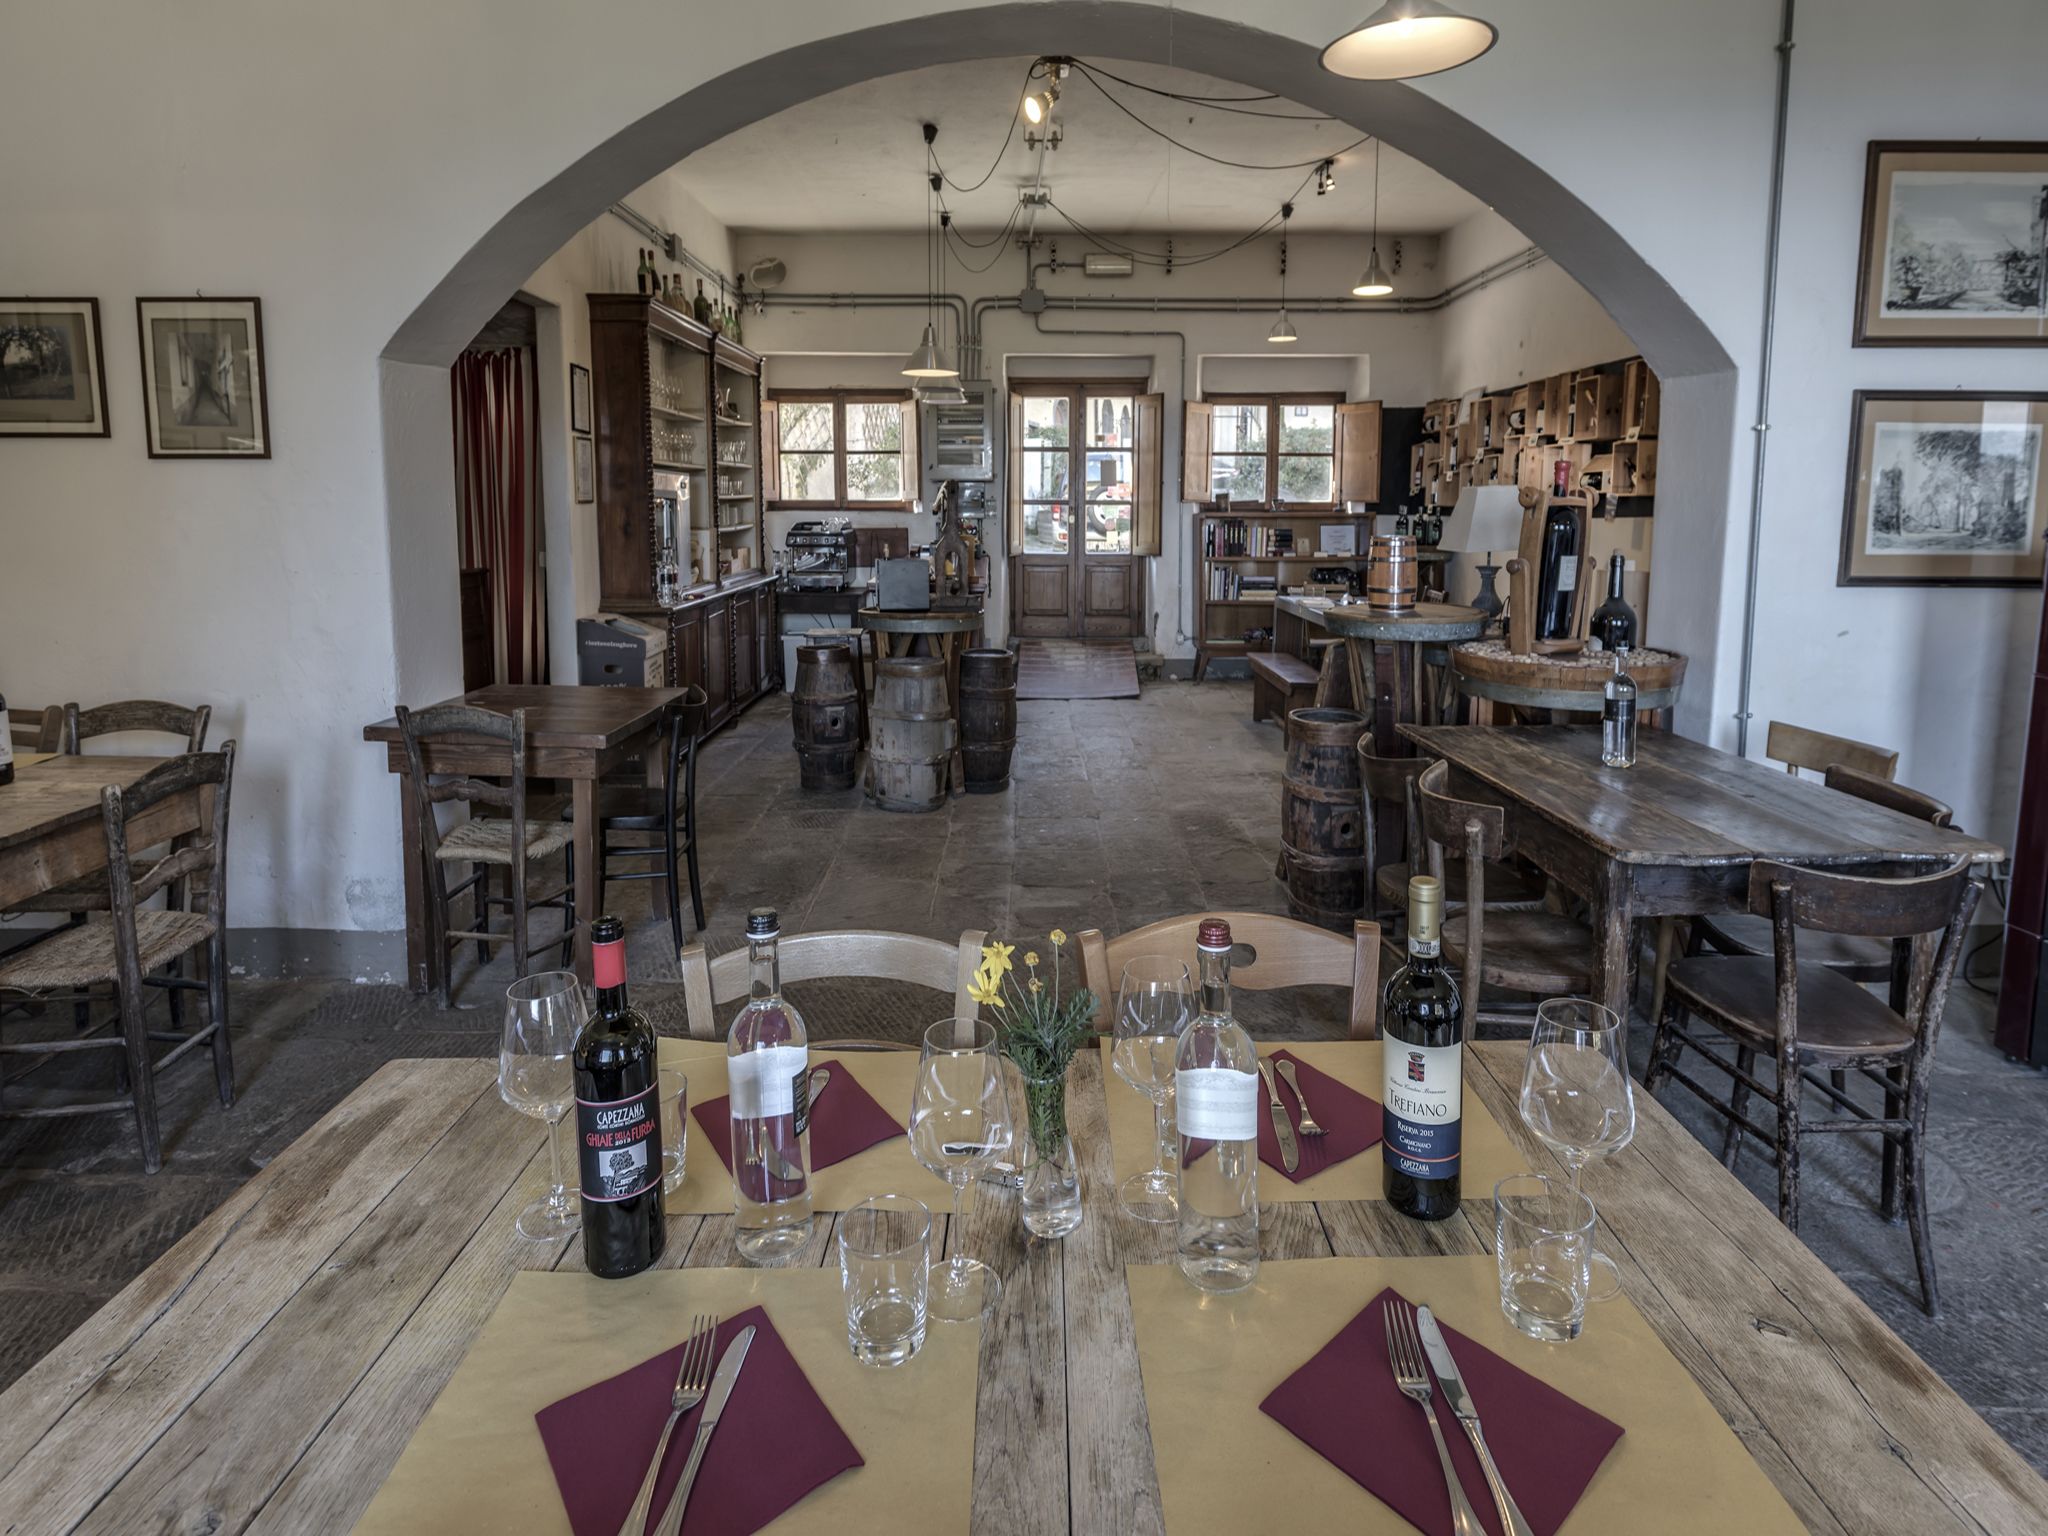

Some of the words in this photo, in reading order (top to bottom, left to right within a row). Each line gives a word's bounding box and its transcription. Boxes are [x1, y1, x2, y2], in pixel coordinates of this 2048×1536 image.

[597, 1102, 645, 1125] CAPEZZANA
[1389, 1088, 1447, 1117] TREFIANO
[586, 1132, 613, 1147] GHIAIE
[614, 1130, 631, 1140] DELLA
[631, 1118, 656, 1141] FURBA
[1400, 1158, 1430, 1172] CAPEZZANA
